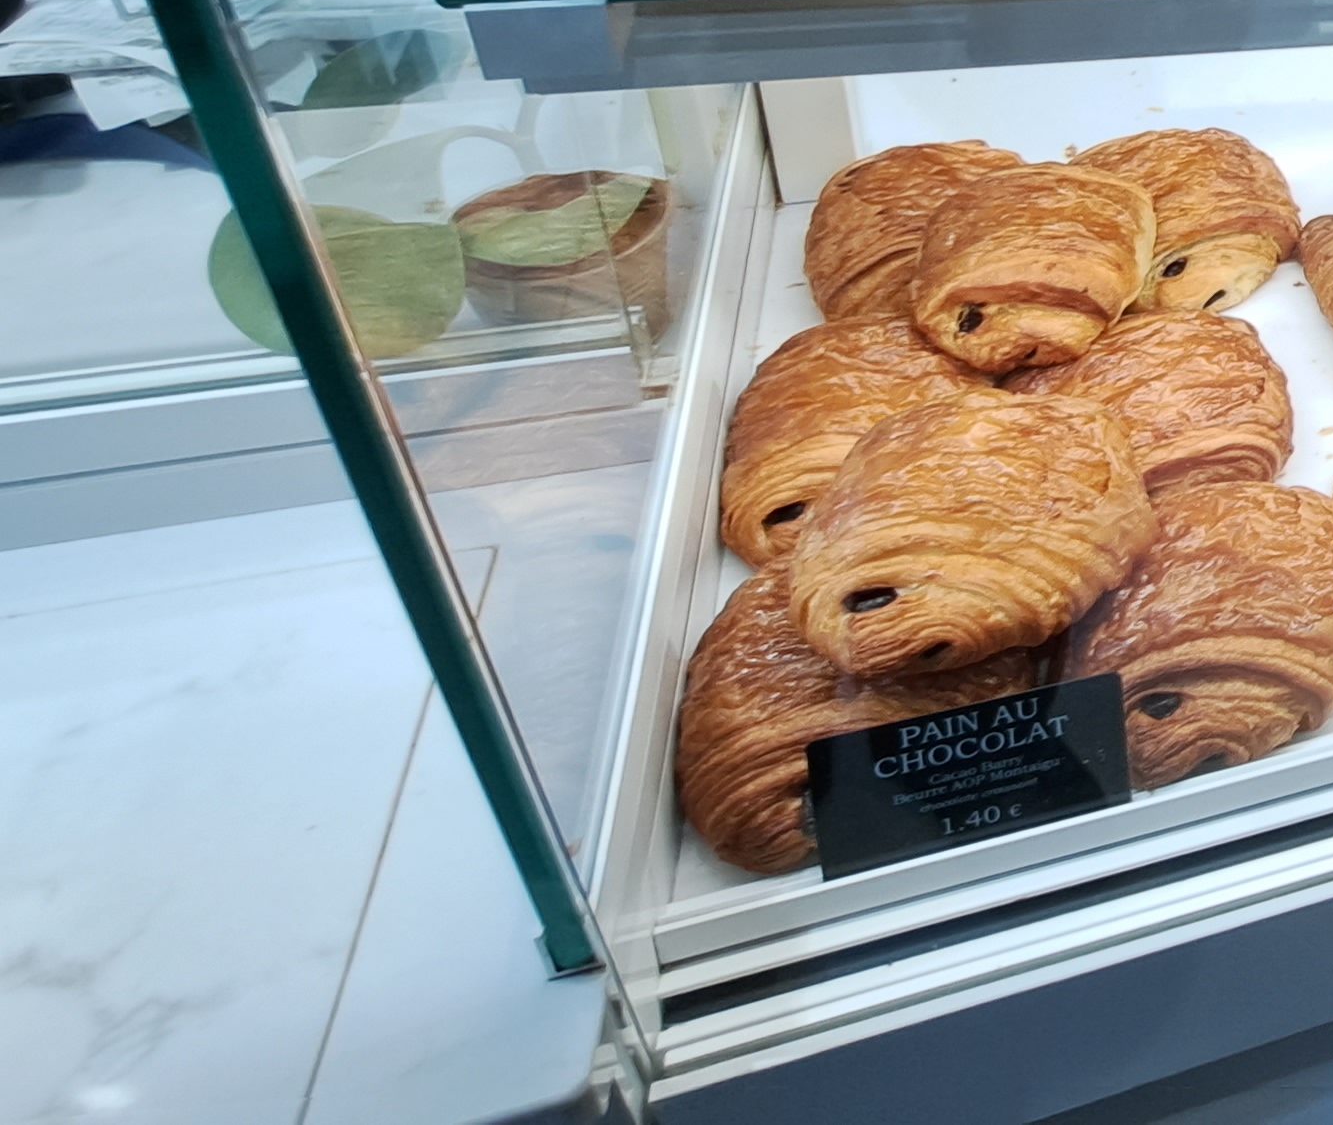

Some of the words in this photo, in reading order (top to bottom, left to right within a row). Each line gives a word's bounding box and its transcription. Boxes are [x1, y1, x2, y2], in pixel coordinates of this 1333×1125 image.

[899, 711, 980, 750] PAIN
[991, 697, 1039, 728] AU
[874, 715, 1070, 779] CHOCOLAT
[928, 764, 978, 785] Cacao
[951, 776, 986, 792] AOP
[991, 758, 1062, 782] Montaigu
[941, 805, 1001, 836] 1.40
[1009, 803, 1023, 818] €
